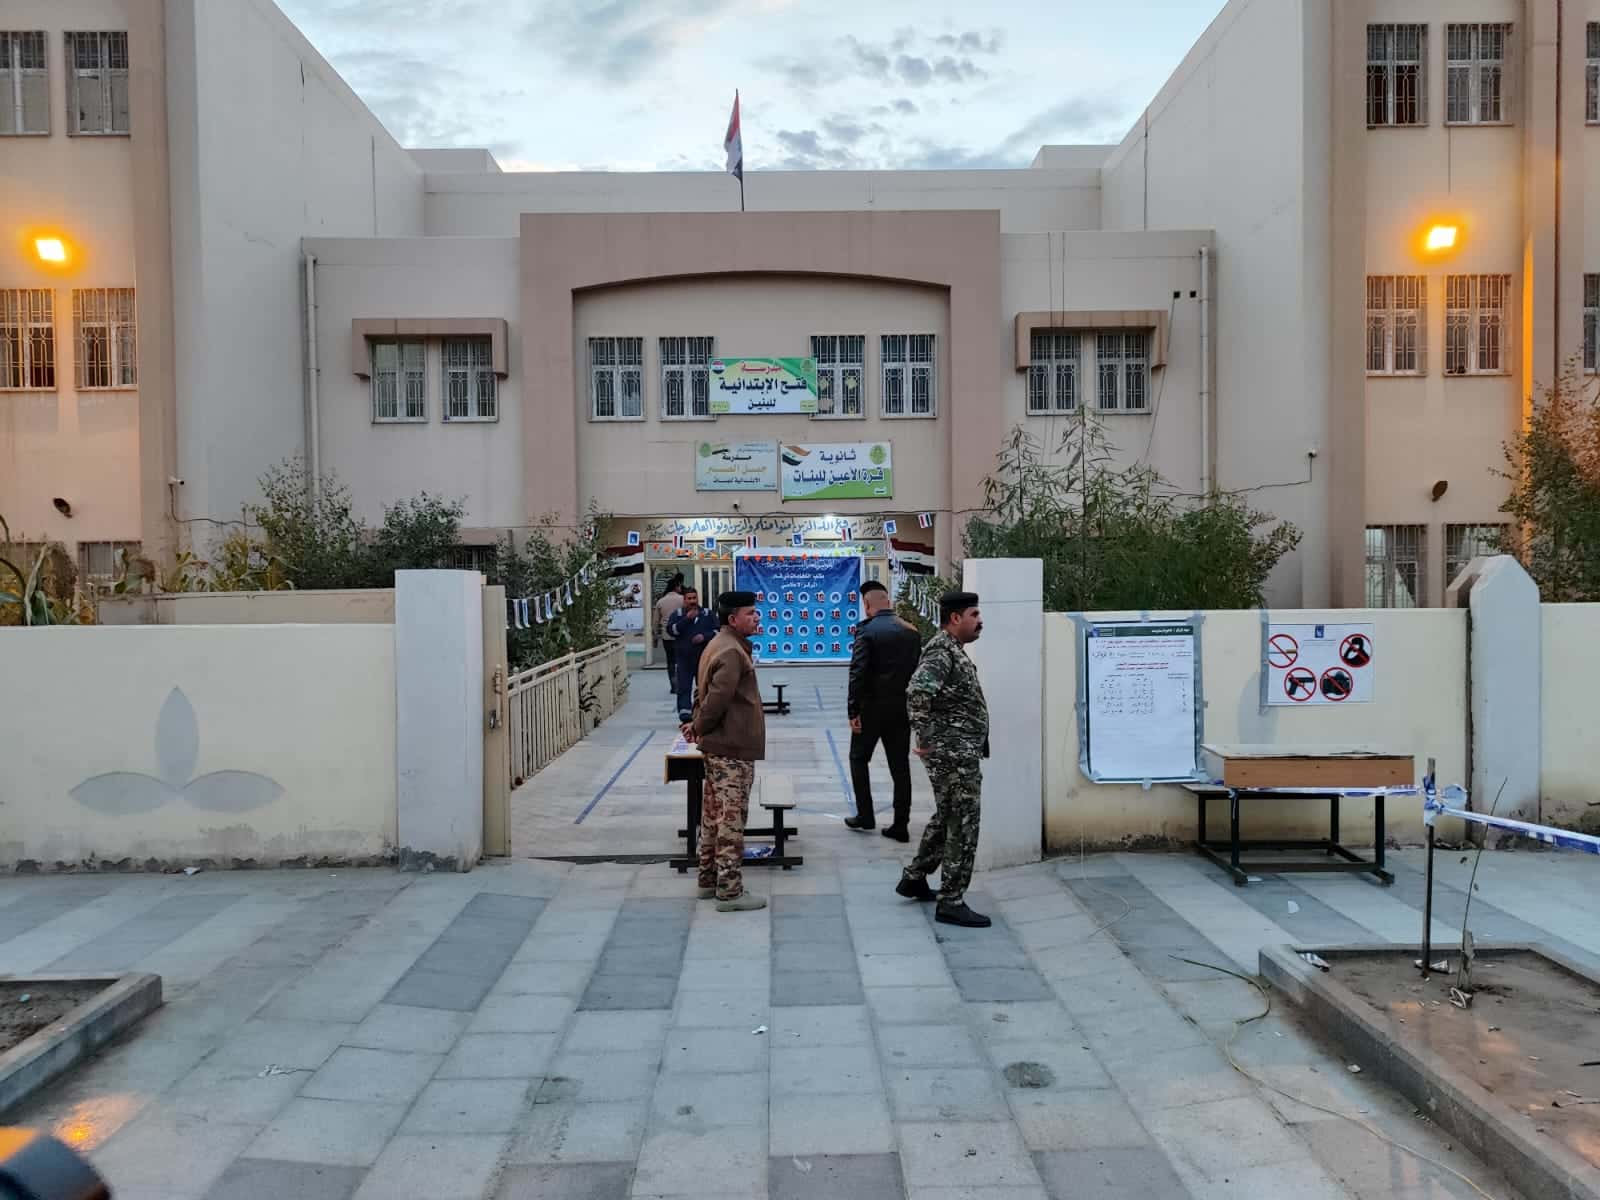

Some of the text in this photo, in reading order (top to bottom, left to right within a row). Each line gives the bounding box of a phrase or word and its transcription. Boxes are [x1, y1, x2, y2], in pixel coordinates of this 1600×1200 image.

[780, 376, 808, 394] فتح
[747, 397, 776, 410] للبنين
[819, 448, 856, 464] ثانوية
[793, 469, 826, 486] للبنات
[863, 466, 884, 485] قرة
